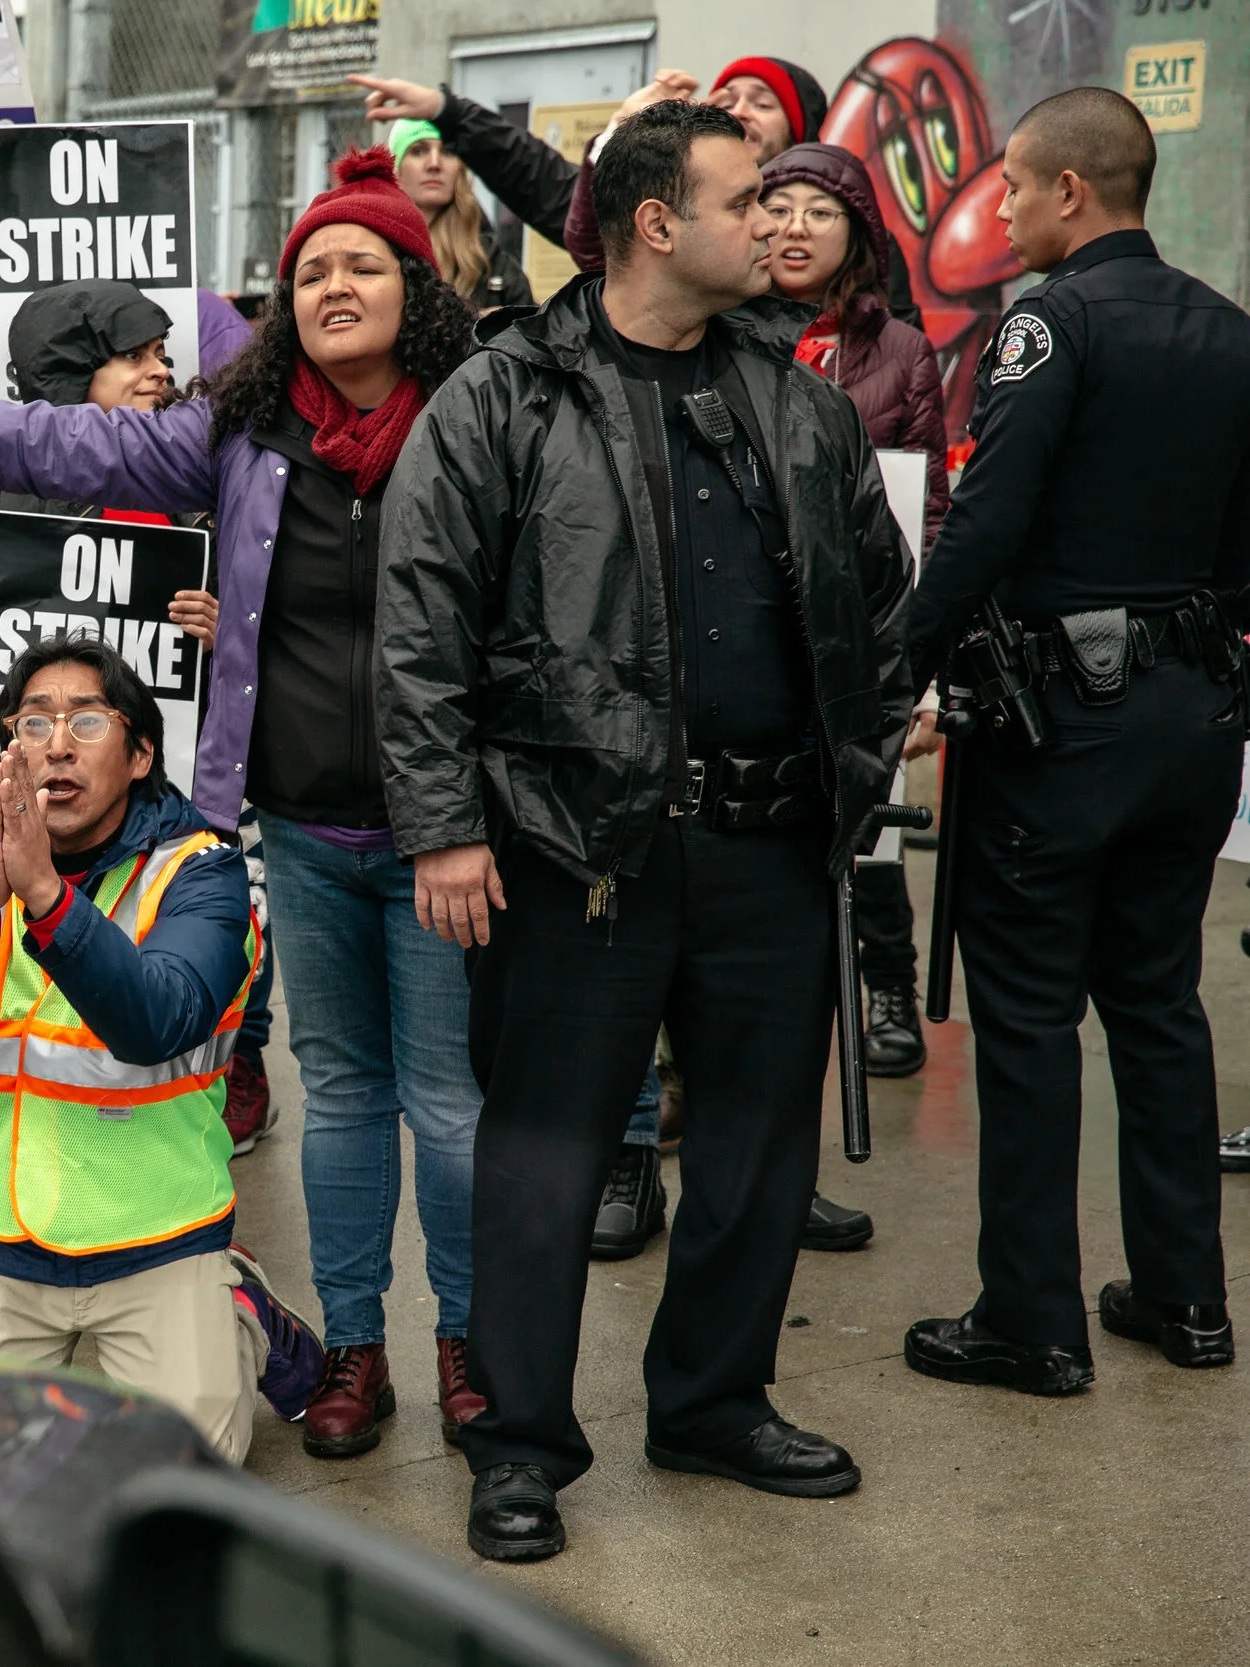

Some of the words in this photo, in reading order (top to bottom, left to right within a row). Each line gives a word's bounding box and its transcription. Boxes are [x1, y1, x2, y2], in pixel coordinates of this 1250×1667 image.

[1134, 57, 1195, 88] EXIT
[49, 139, 119, 206] ON
[1009, 318, 1048, 349] ANGELES
[994, 364, 1025, 377] POLICE
[60, 533, 134, 606] ON
